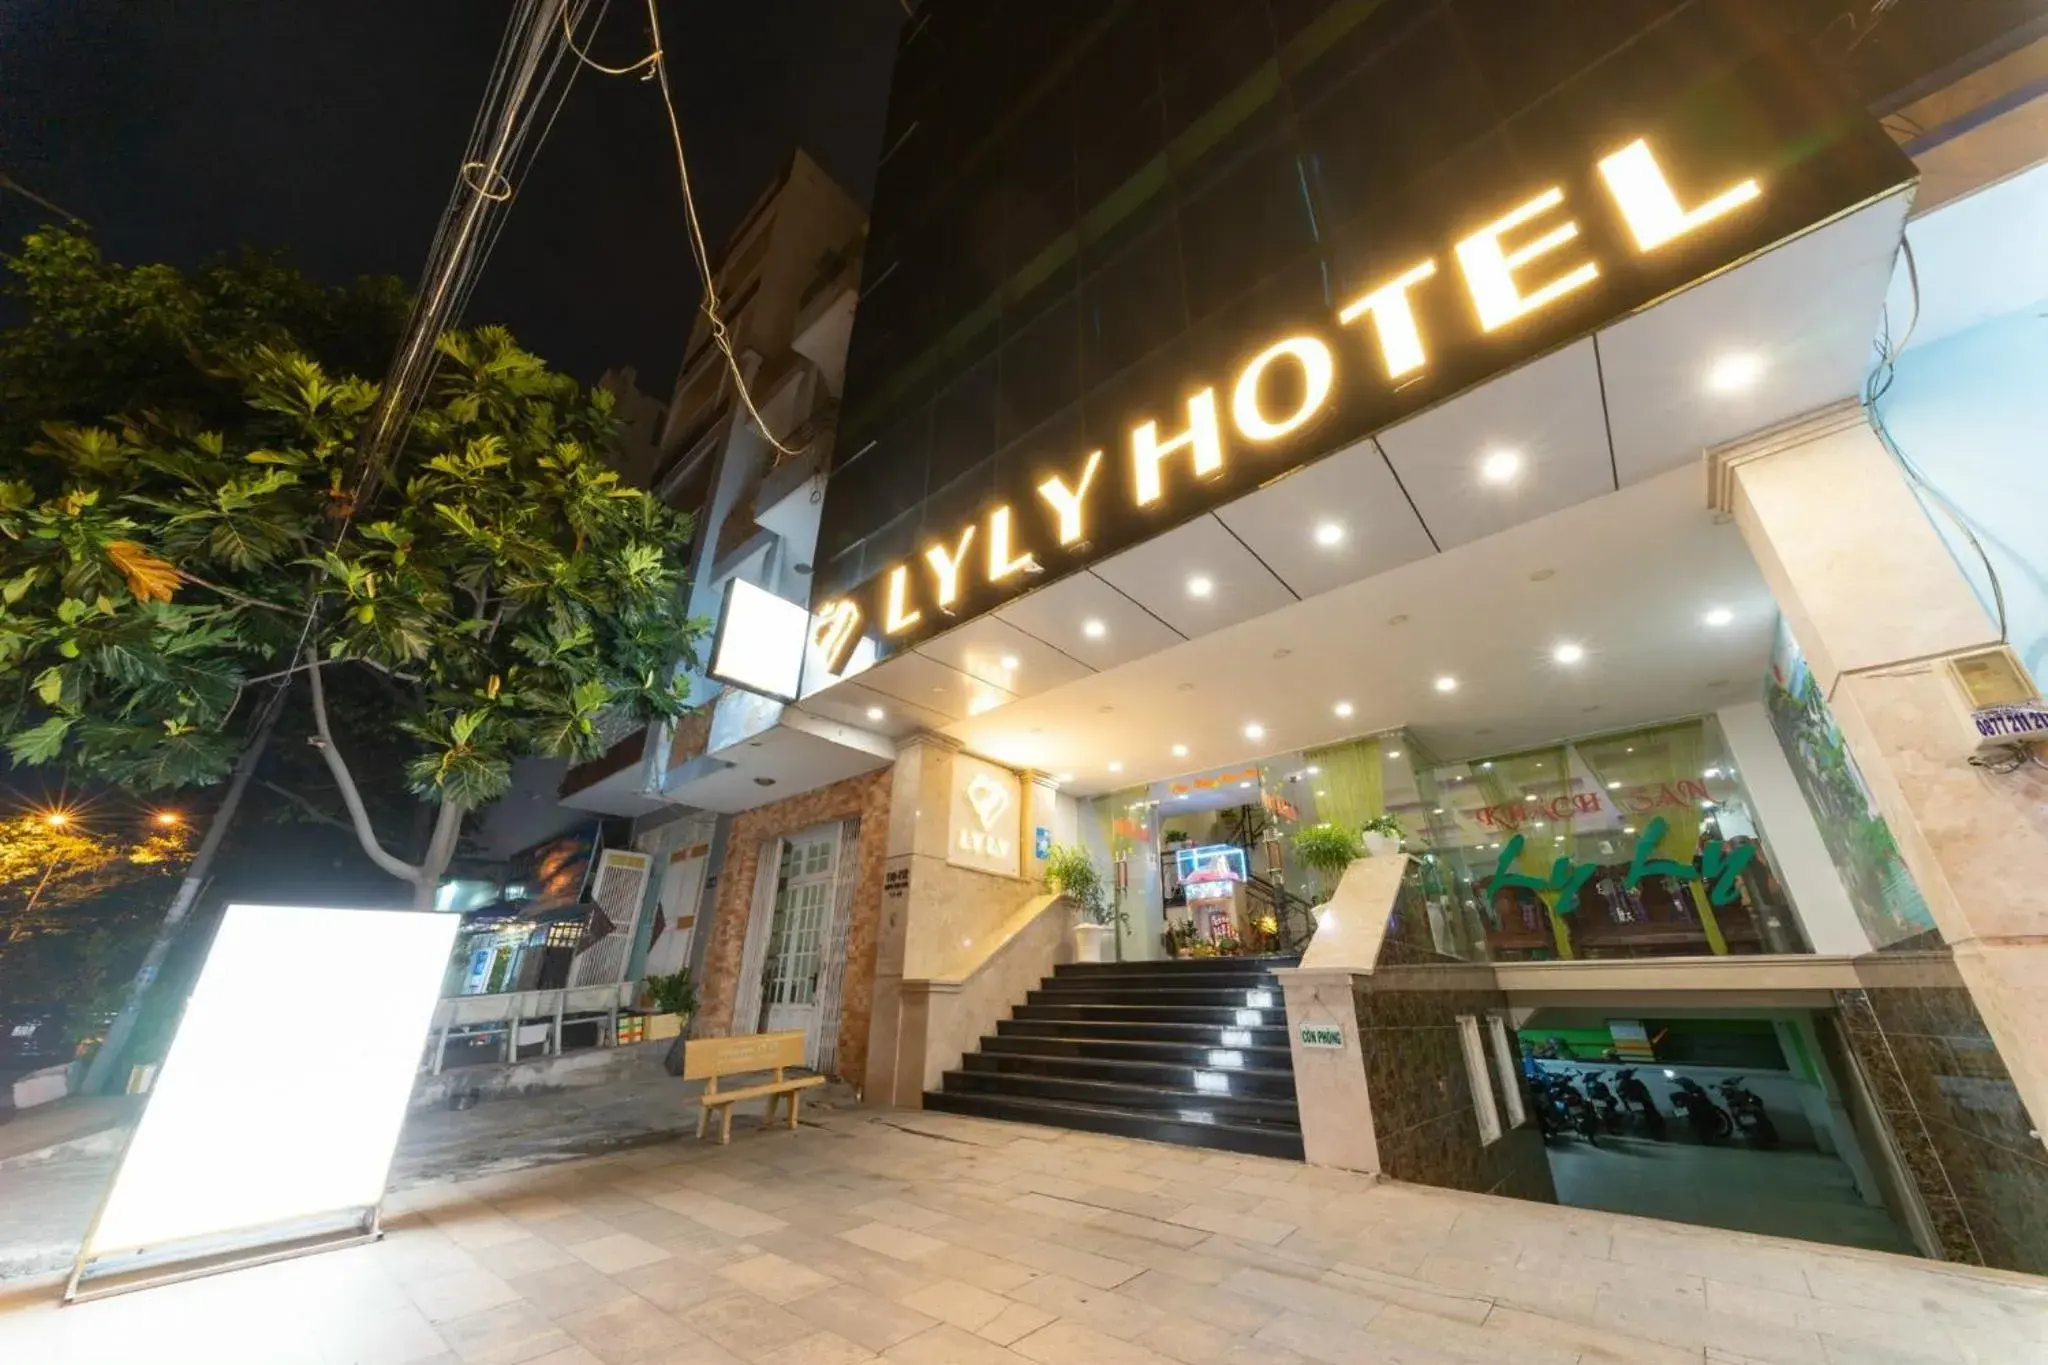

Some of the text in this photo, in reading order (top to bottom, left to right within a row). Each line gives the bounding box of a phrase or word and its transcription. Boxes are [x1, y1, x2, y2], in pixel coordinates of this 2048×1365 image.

[886, 138, 1761, 634] LYLY HOTEL
[1976, 715, 2010, 736] 0877
